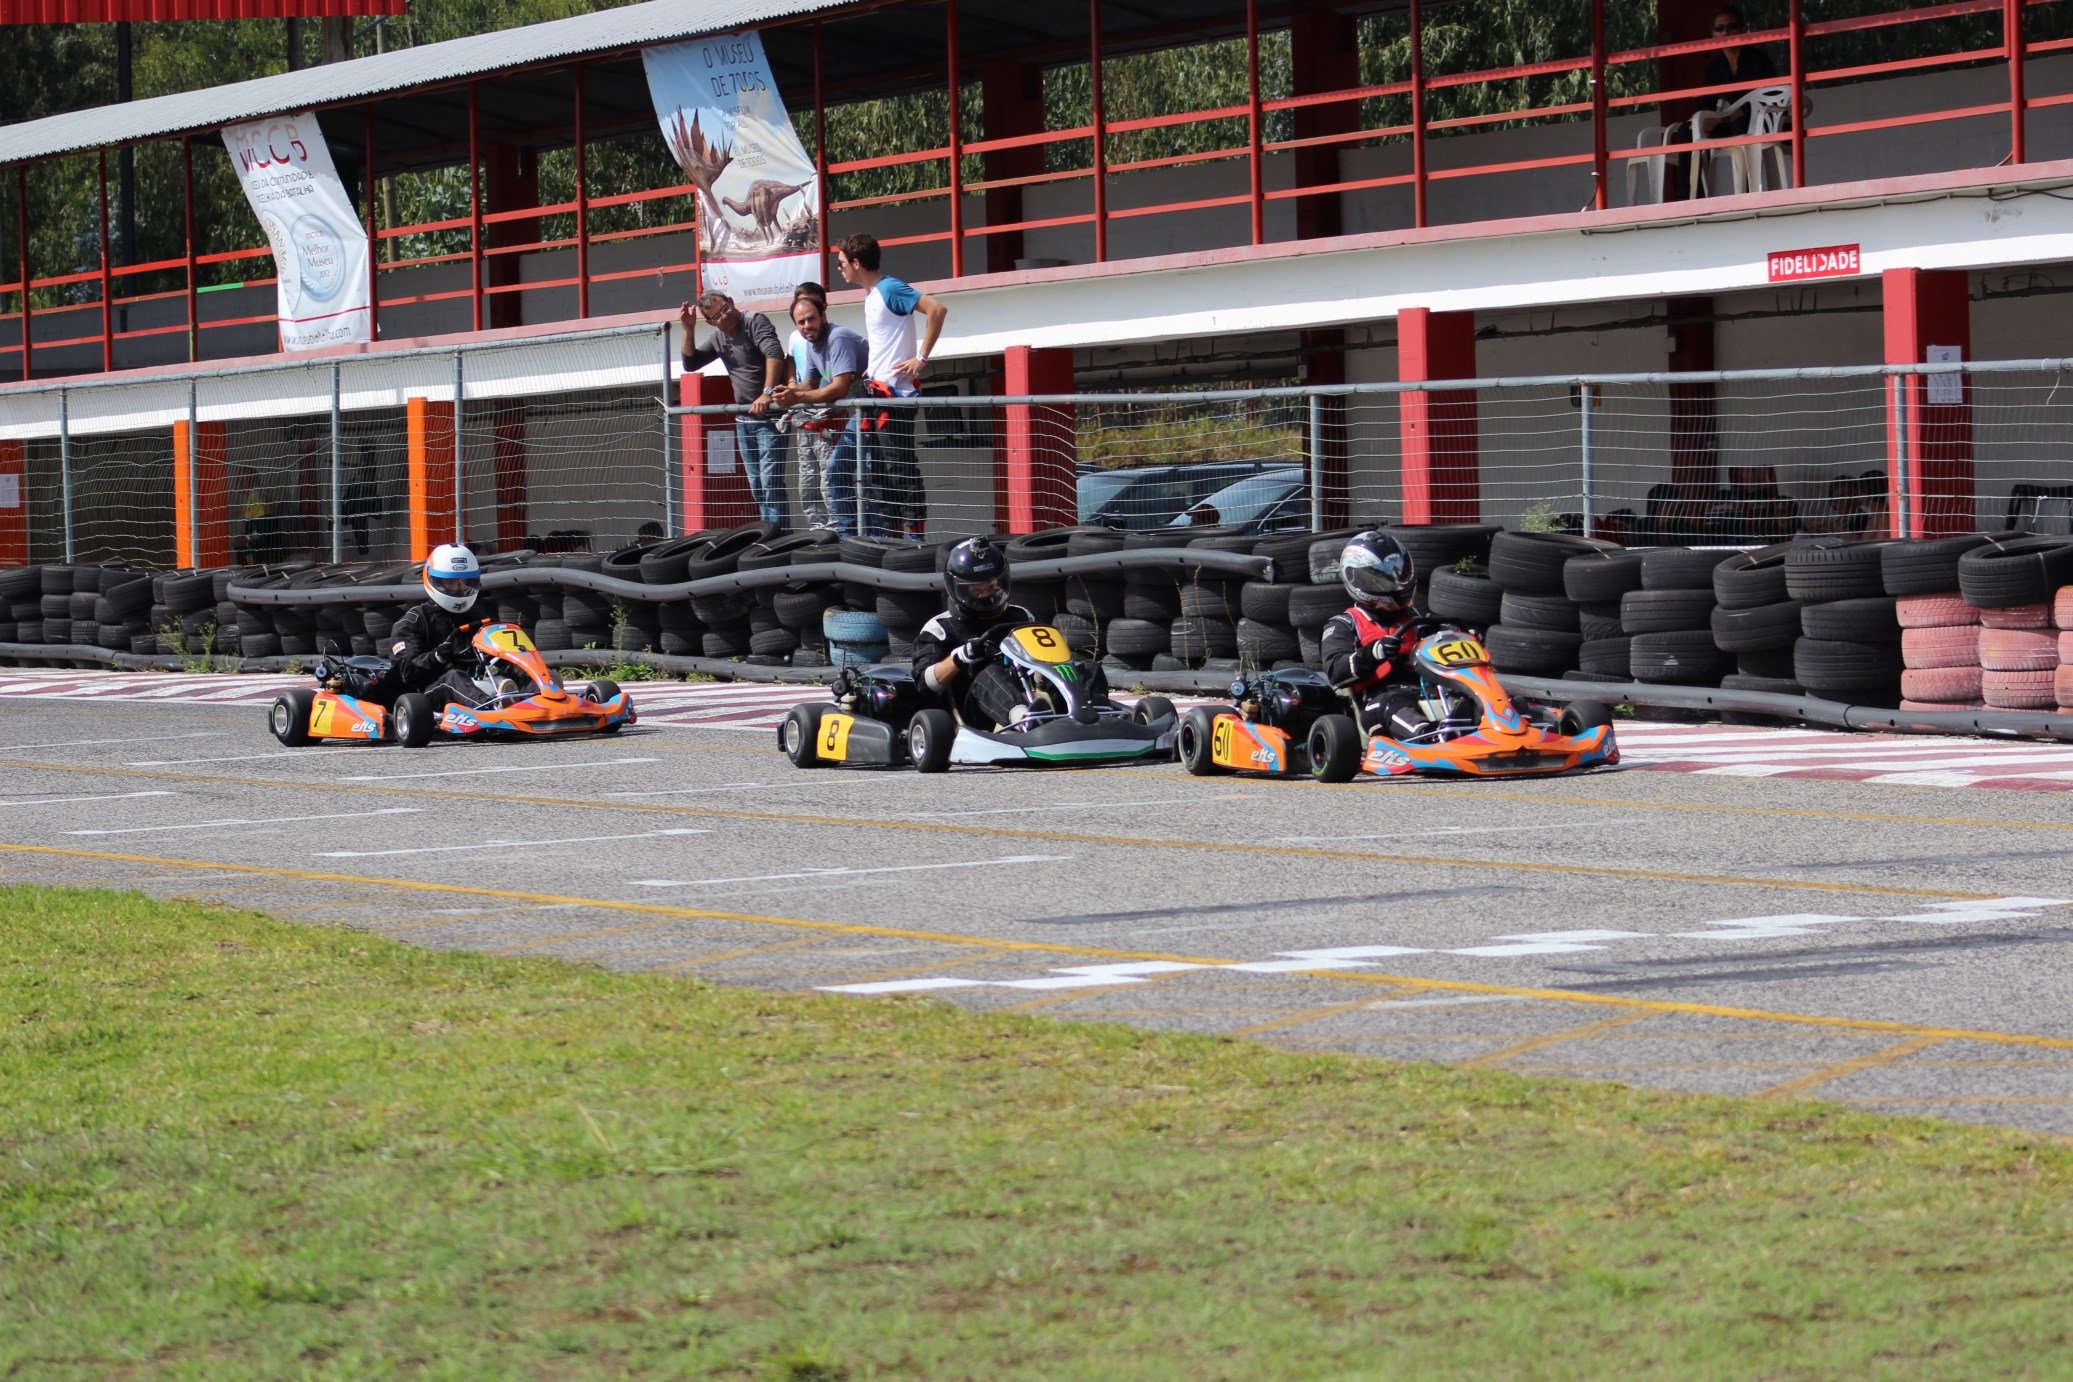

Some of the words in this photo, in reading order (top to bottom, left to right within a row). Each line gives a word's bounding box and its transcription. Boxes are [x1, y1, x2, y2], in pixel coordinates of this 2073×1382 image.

[702, 47, 714, 69] O
[714, 41, 755, 66] MUSEU
[710, 75, 730, 98] DE
[302, 243, 329, 257] Melhor
[307, 257, 334, 269] Museu
[1771, 250, 1857, 277] FIDELIDADE
[502, 630, 520, 647] 7
[1032, 628, 1056, 648] 8
[1437, 641, 1480, 663] 60
[314, 700, 328, 728] 7
[826, 719, 840, 751] 8
[1214, 721, 1230, 761] 60
